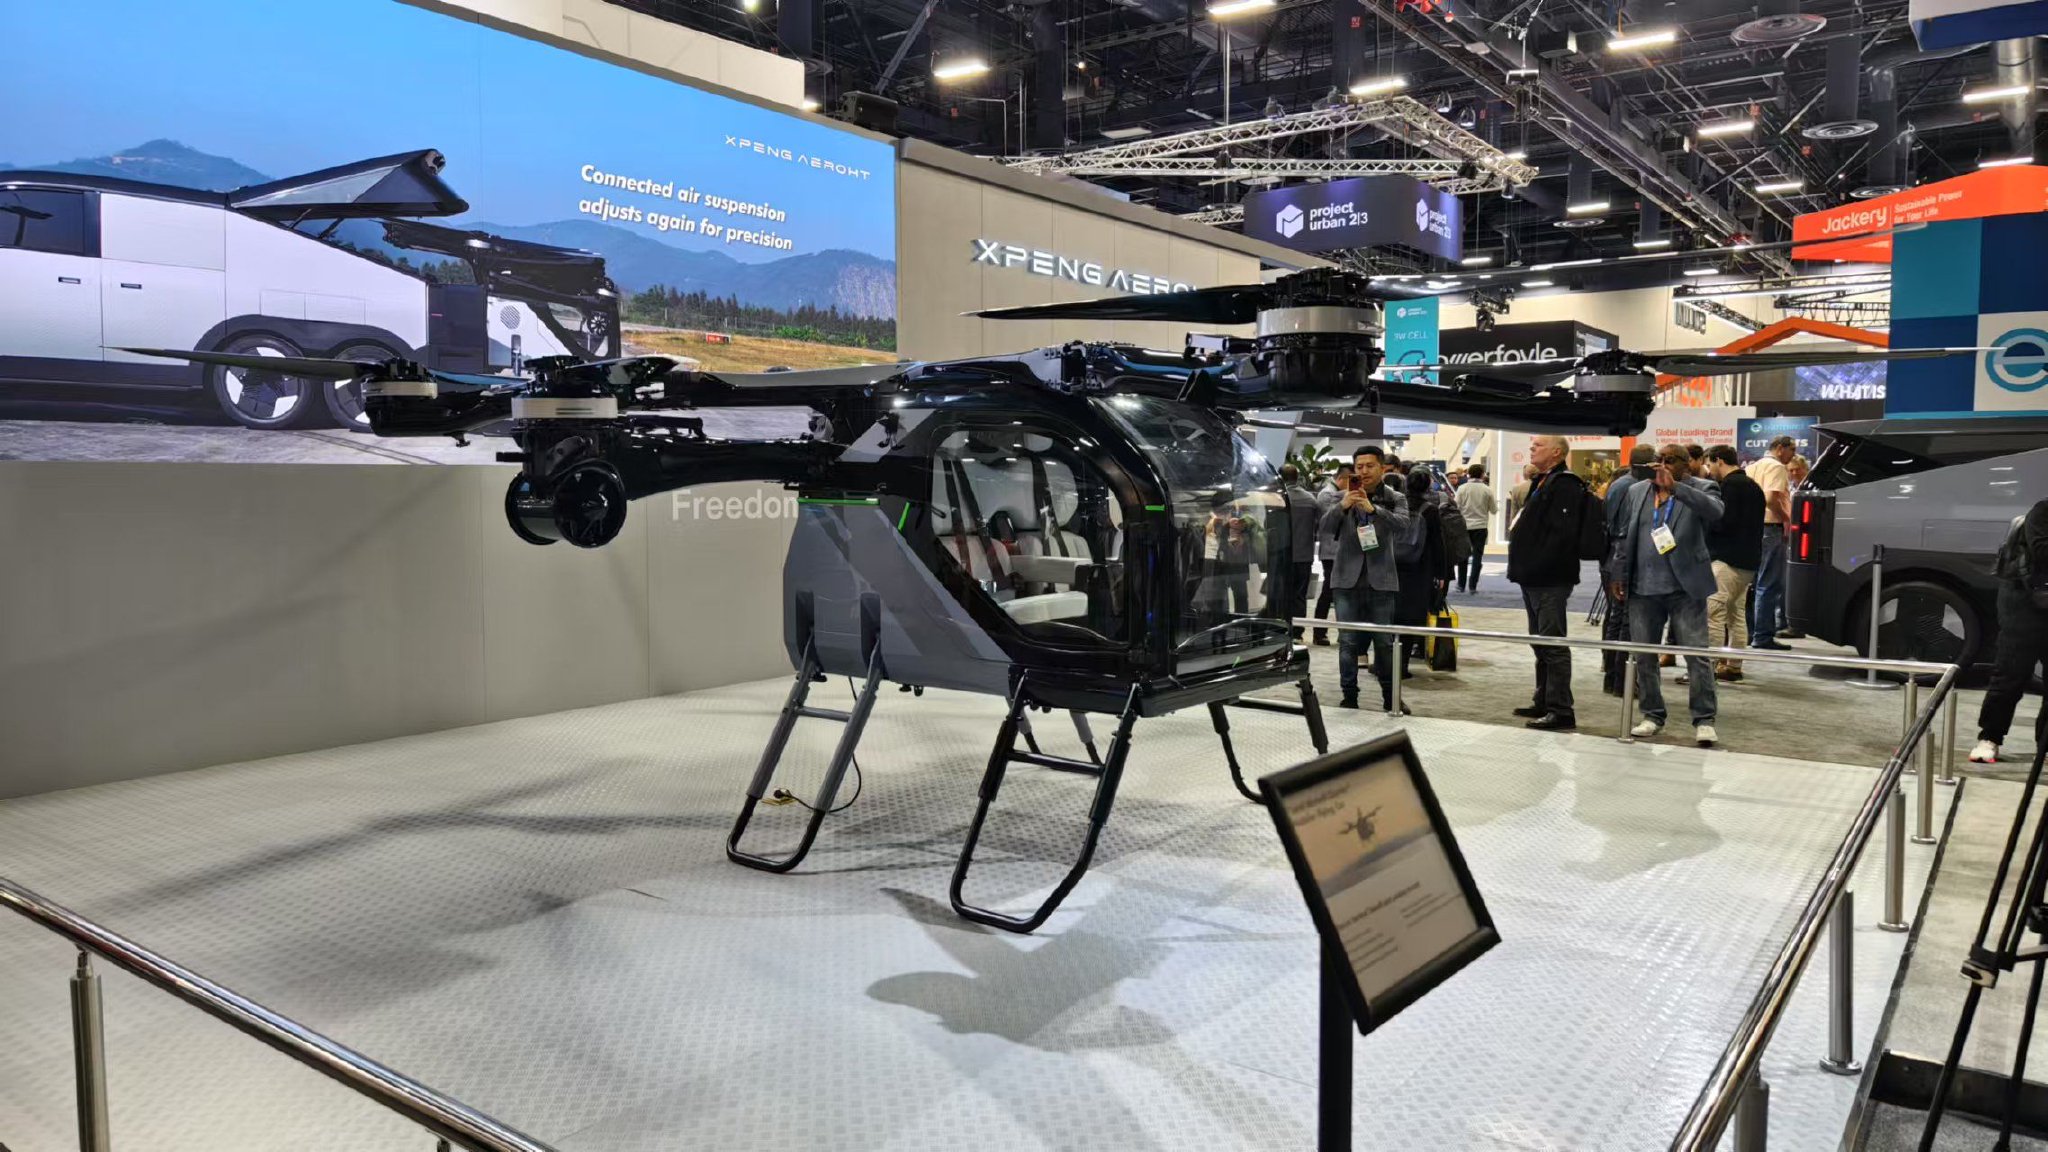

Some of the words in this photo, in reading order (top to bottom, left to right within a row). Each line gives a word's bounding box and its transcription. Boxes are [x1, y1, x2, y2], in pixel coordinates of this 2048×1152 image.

[725, 134, 793, 161] XPENG
[581, 164, 674, 198] Connected
[677, 186, 701, 204] air
[704, 193, 786, 222] suspension
[1938, 190, 1963, 203] Power
[1309, 201, 1354, 221] project
[1822, 206, 1887, 234] Jackery
[1906, 211, 1922, 222] Your
[1924, 206, 1938, 218] Life
[579, 197, 642, 221] adjusts
[647, 214, 695, 232] again
[700, 218, 723, 237] for
[726, 228, 793, 250] precision
[1309, 216, 1346, 231] urban
[975, 239, 1101, 285] XPENG
[1656, 428, 1678, 436] Global
[1680, 428, 1709, 438] Leading
[1710, 428, 1733, 436] Brand
[1745, 439, 1768, 448] CUT
